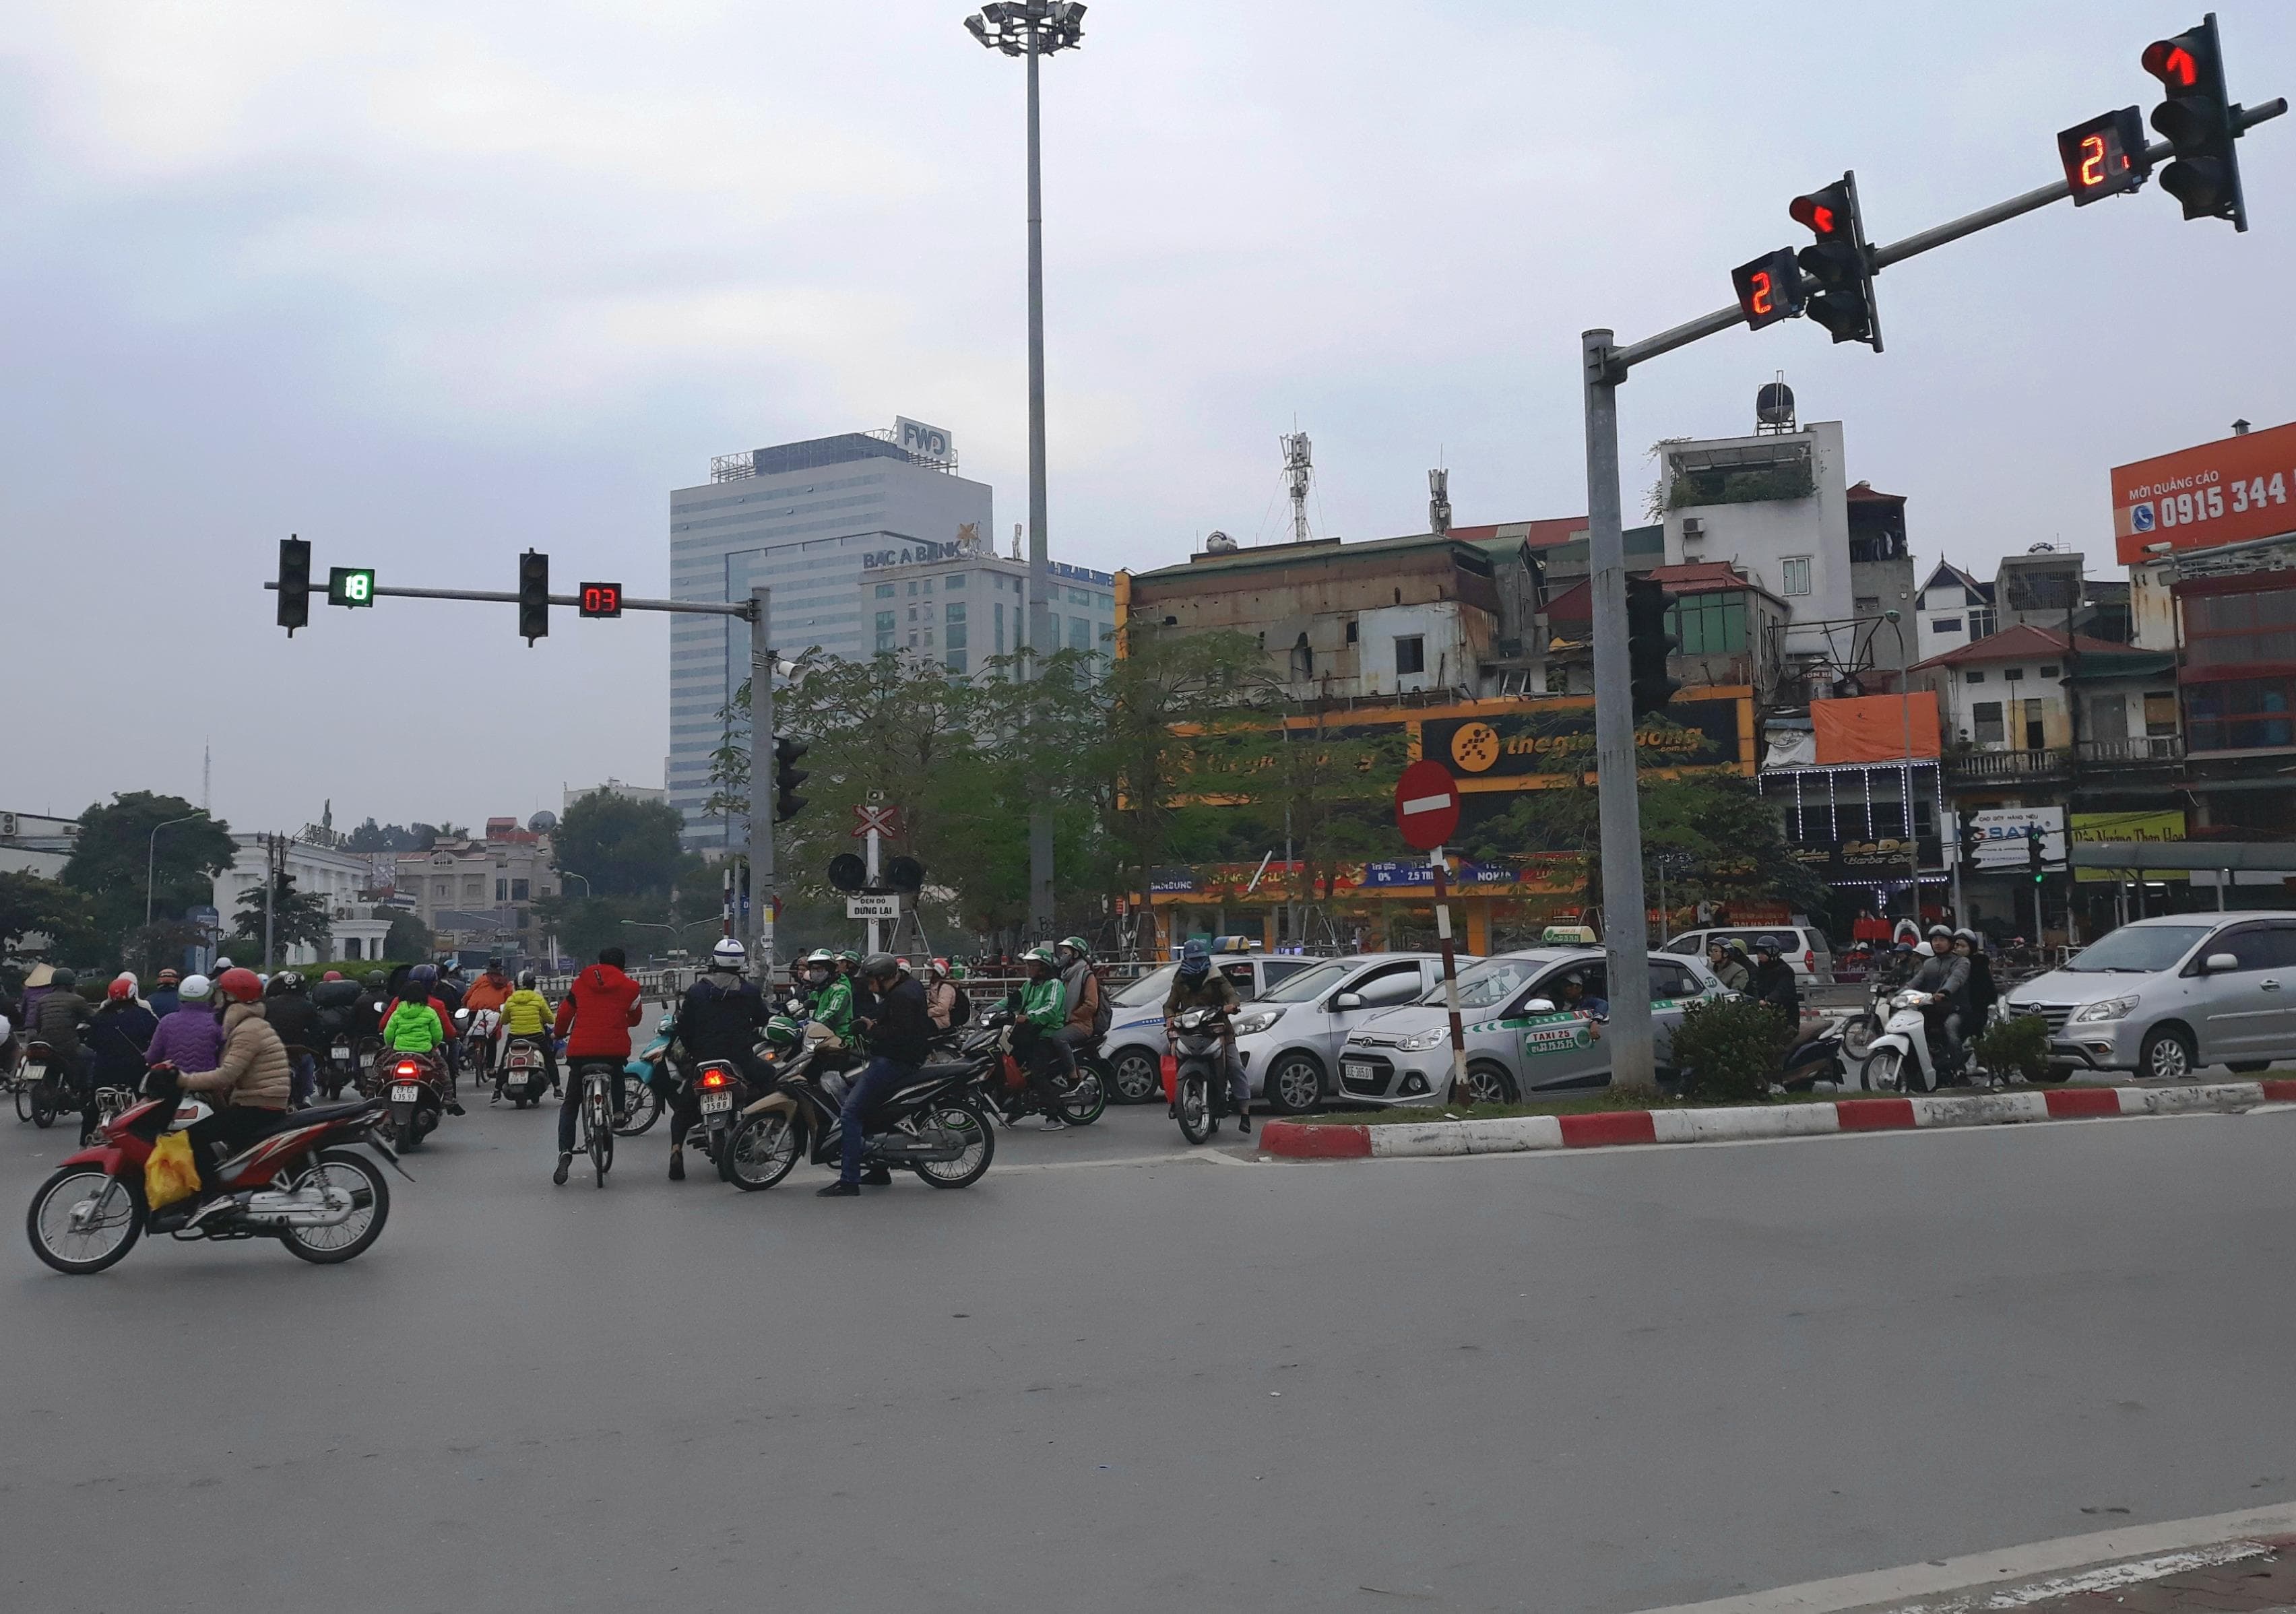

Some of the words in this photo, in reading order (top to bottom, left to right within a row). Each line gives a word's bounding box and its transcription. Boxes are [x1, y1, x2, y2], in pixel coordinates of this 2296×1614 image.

[904, 422, 946, 455] FWD
[2153, 476, 2194, 495] QUẢNG
[2195, 469, 2219, 486] CÁO
[2161, 485, 2225, 528] 0915
[2231, 471, 2287, 513] 344
[863, 550, 897, 570] BAC
[899, 548, 912, 564] A
[345, 574, 368, 600] 18
[584, 588, 616, 612] 03
[1377, 872, 1391, 881] 0%
[1533, 1031, 1555, 1041] TAXI
[1558, 1029, 1570, 1038] 25
